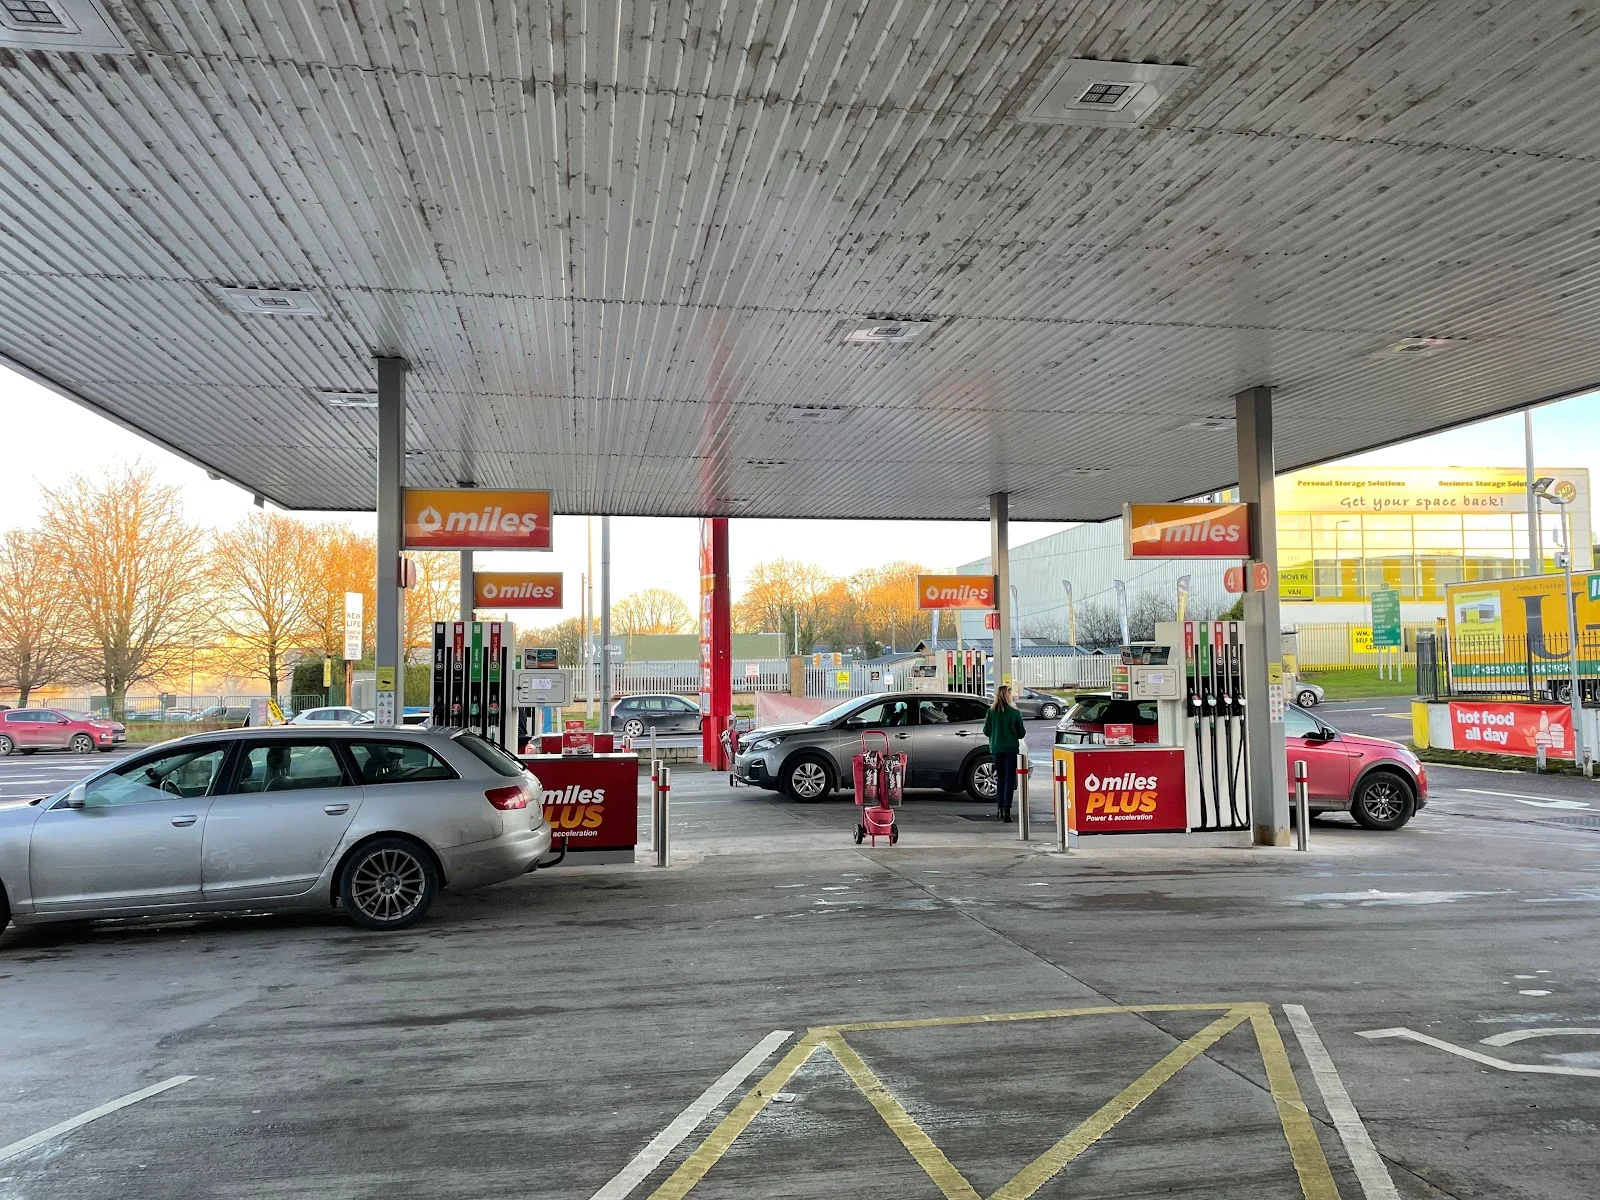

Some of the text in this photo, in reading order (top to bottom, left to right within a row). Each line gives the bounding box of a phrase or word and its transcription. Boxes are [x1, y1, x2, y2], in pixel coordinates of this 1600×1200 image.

[1334, 480, 1366, 489] Storage
[1475, 481, 1506, 489] Storage
[1340, 495, 1505, 512] Get your space back!
[444, 507, 539, 532] miles
[1165, 519, 1241, 543] miles
[1226, 572, 1236, 589] 4
[1261, 567, 1268, 586] 3
[498, 583, 555, 599] miles
[939, 584, 989, 601] miles
[1456, 709, 1515, 726] hot food
[1465, 727, 1509, 745] all day
[1101, 772, 1159, 791] miles
[541, 784, 606, 804] miles
[1085, 790, 1159, 814] PLUS
[543, 804, 606, 829] LUS
[1085, 814, 1107, 822] Power
[1113, 813, 1154, 821] acceleration
[552, 829, 598, 838] acceleration
